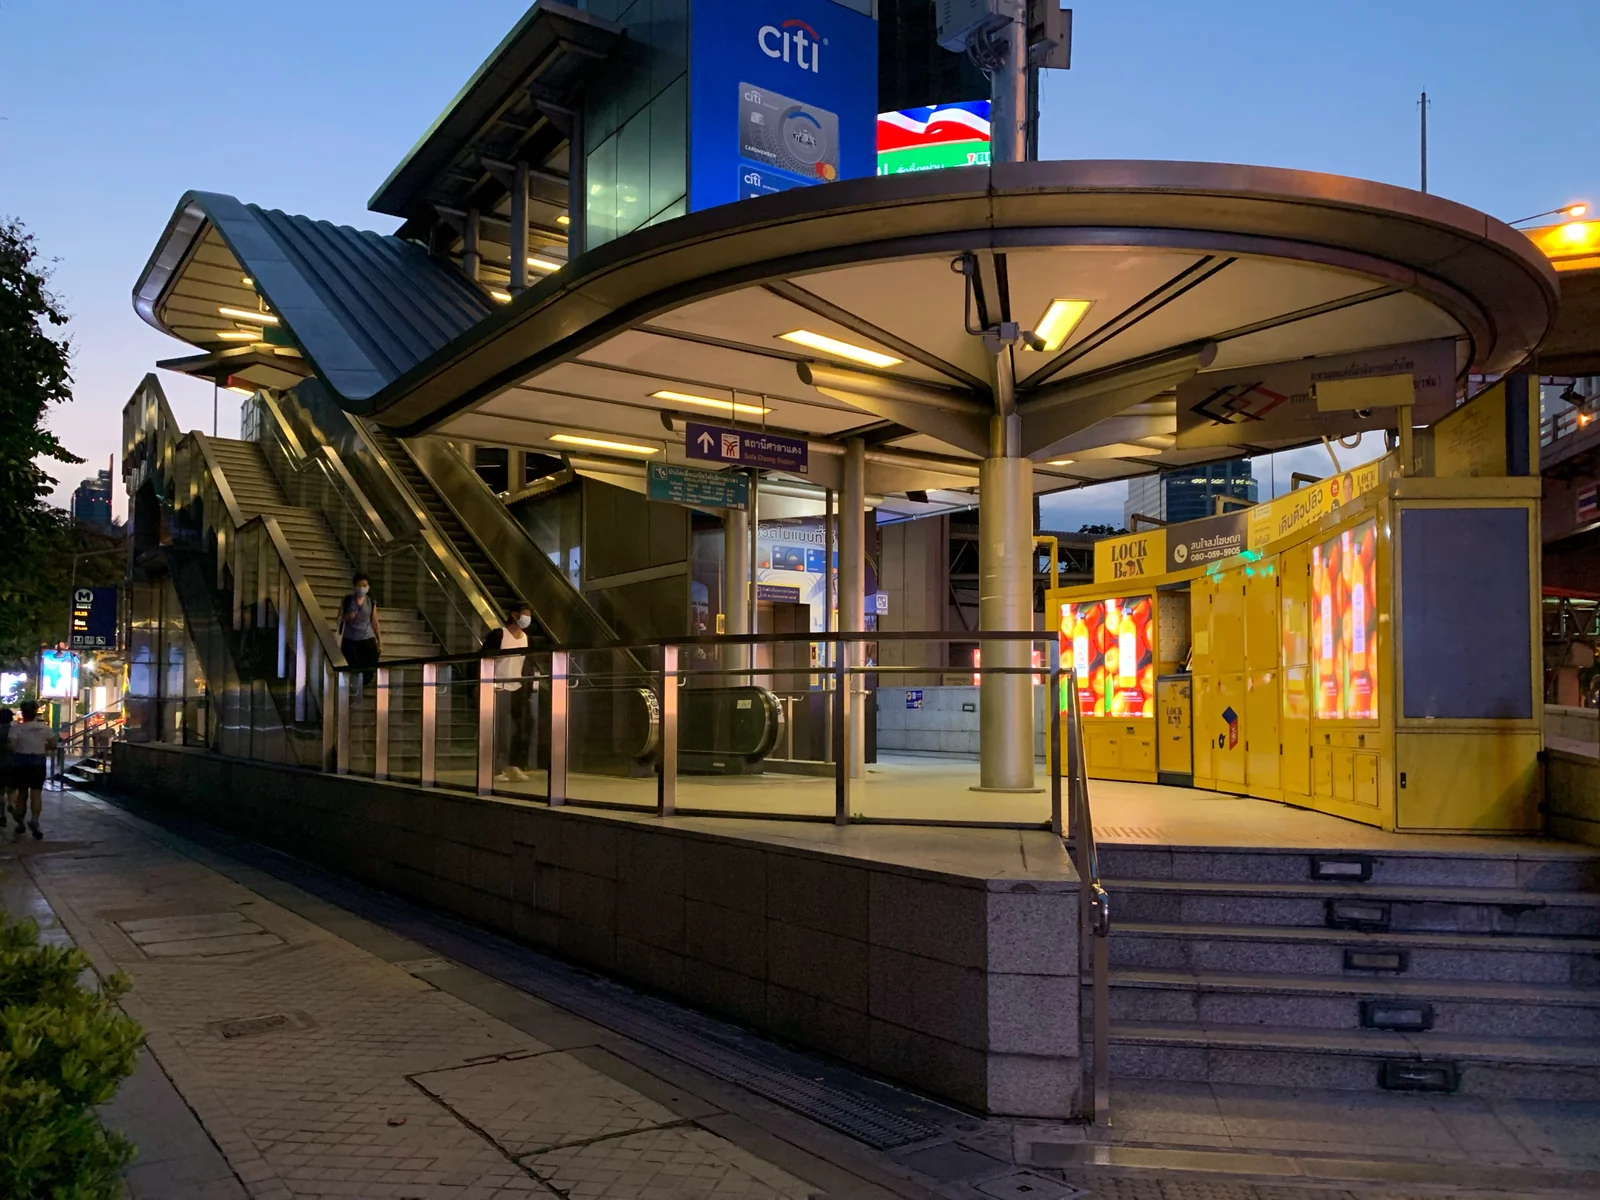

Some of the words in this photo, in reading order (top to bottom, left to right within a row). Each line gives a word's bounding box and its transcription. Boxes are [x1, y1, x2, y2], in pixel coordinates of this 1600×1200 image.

[758, 23, 819, 74] citi
[744, 91, 761, 105] citi
[744, 144, 777, 158] CARDMEMBER
[744, 173, 761, 187] citi
[1190, 534, 1241, 550] สนใจลงโฆษณา
[1111, 539, 1148, 562] LOCK
[1190, 546, 1241, 562] 080-059-5905
